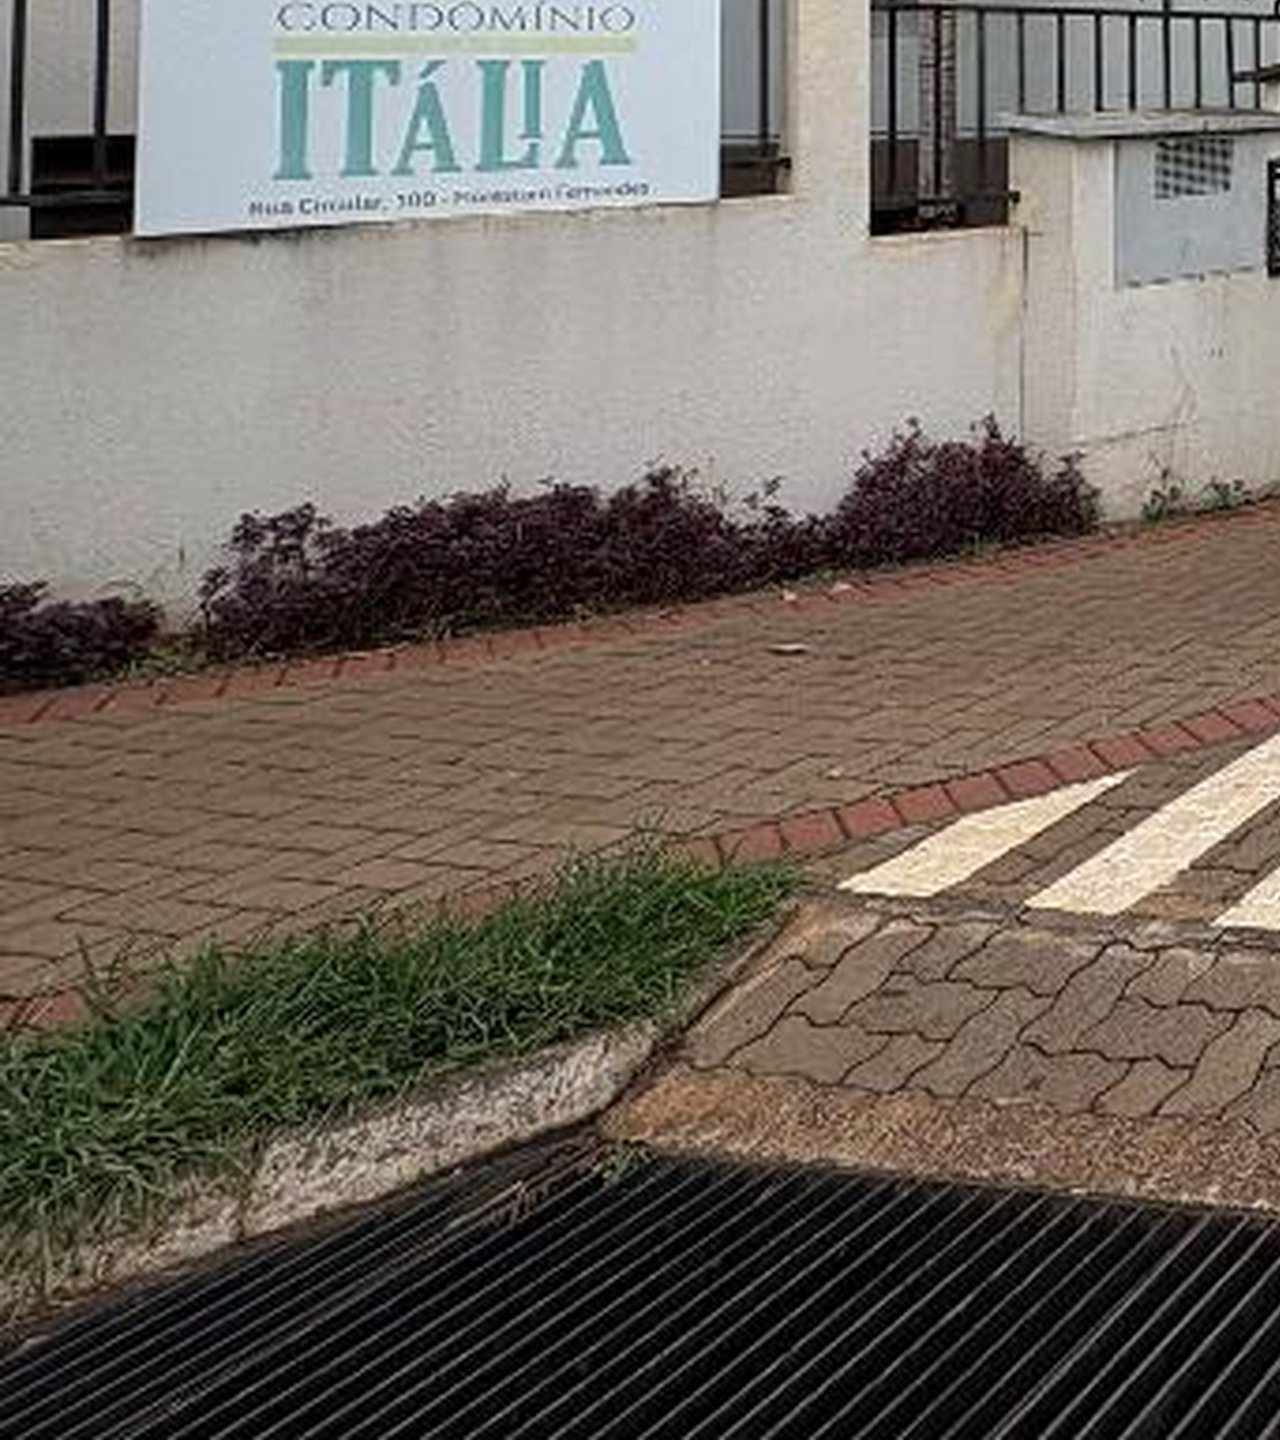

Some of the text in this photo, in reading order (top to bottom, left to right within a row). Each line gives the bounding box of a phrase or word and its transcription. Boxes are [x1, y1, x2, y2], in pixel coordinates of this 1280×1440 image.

[276, 0, 635, 32] CONDOMÍNIO
[272, 59, 632, 180] ITÁLIA
[249, 200, 294, 216] Rua
[299, 193, 388, 215] Circular,
